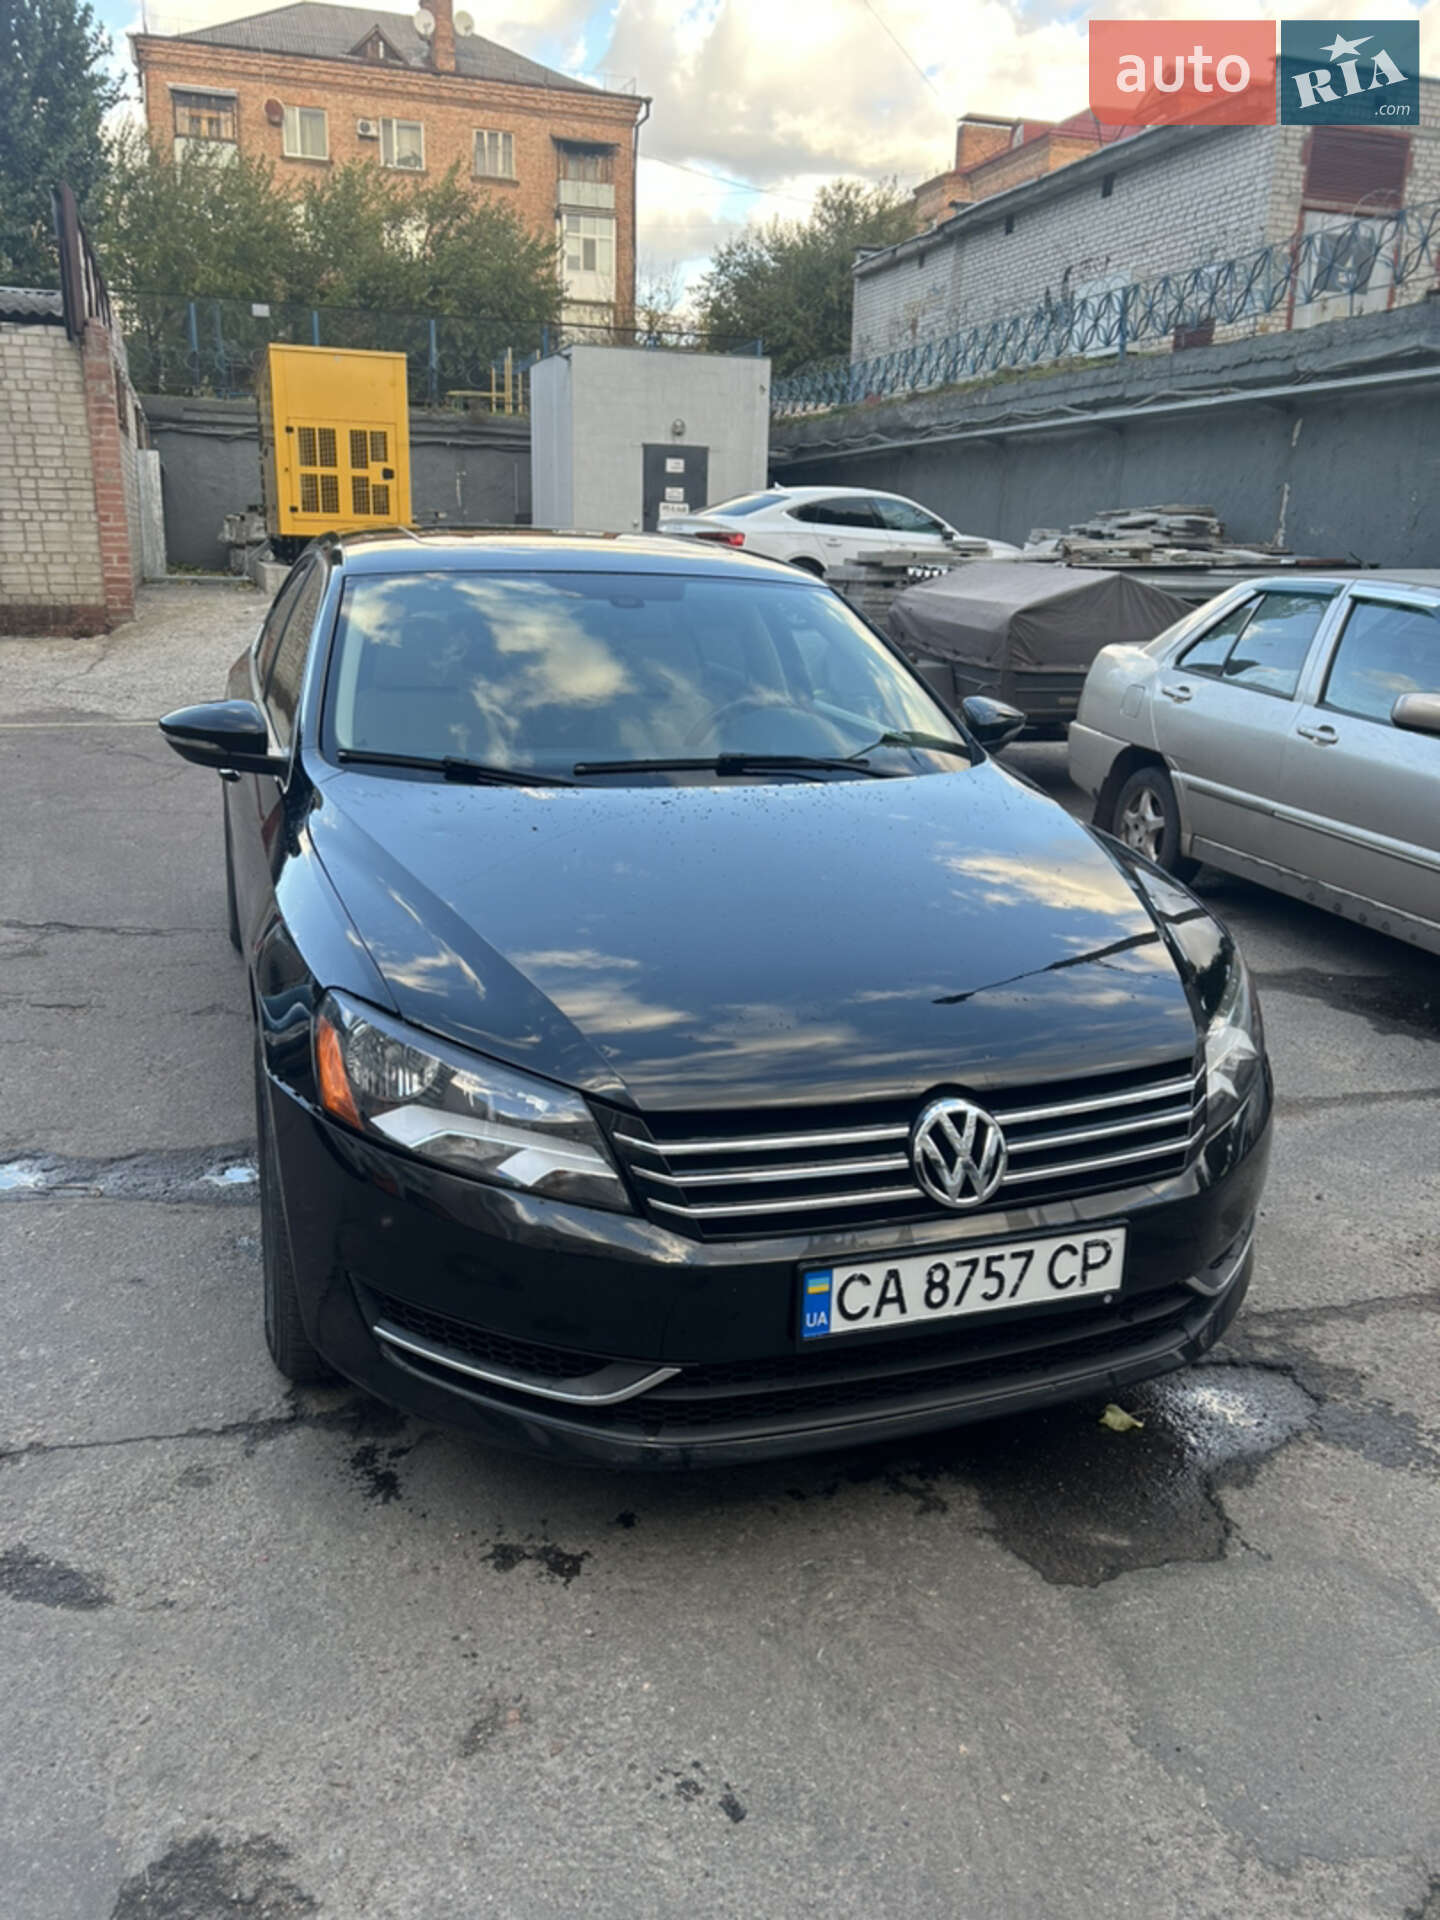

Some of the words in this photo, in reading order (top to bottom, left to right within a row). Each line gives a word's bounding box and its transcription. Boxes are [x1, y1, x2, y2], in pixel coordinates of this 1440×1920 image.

[836, 1269, 907, 1321] CA
[924, 1249, 1035, 1310] 8757
[1047, 1239, 1112, 1290] CP
[806, 1312, 828, 1328] UA
